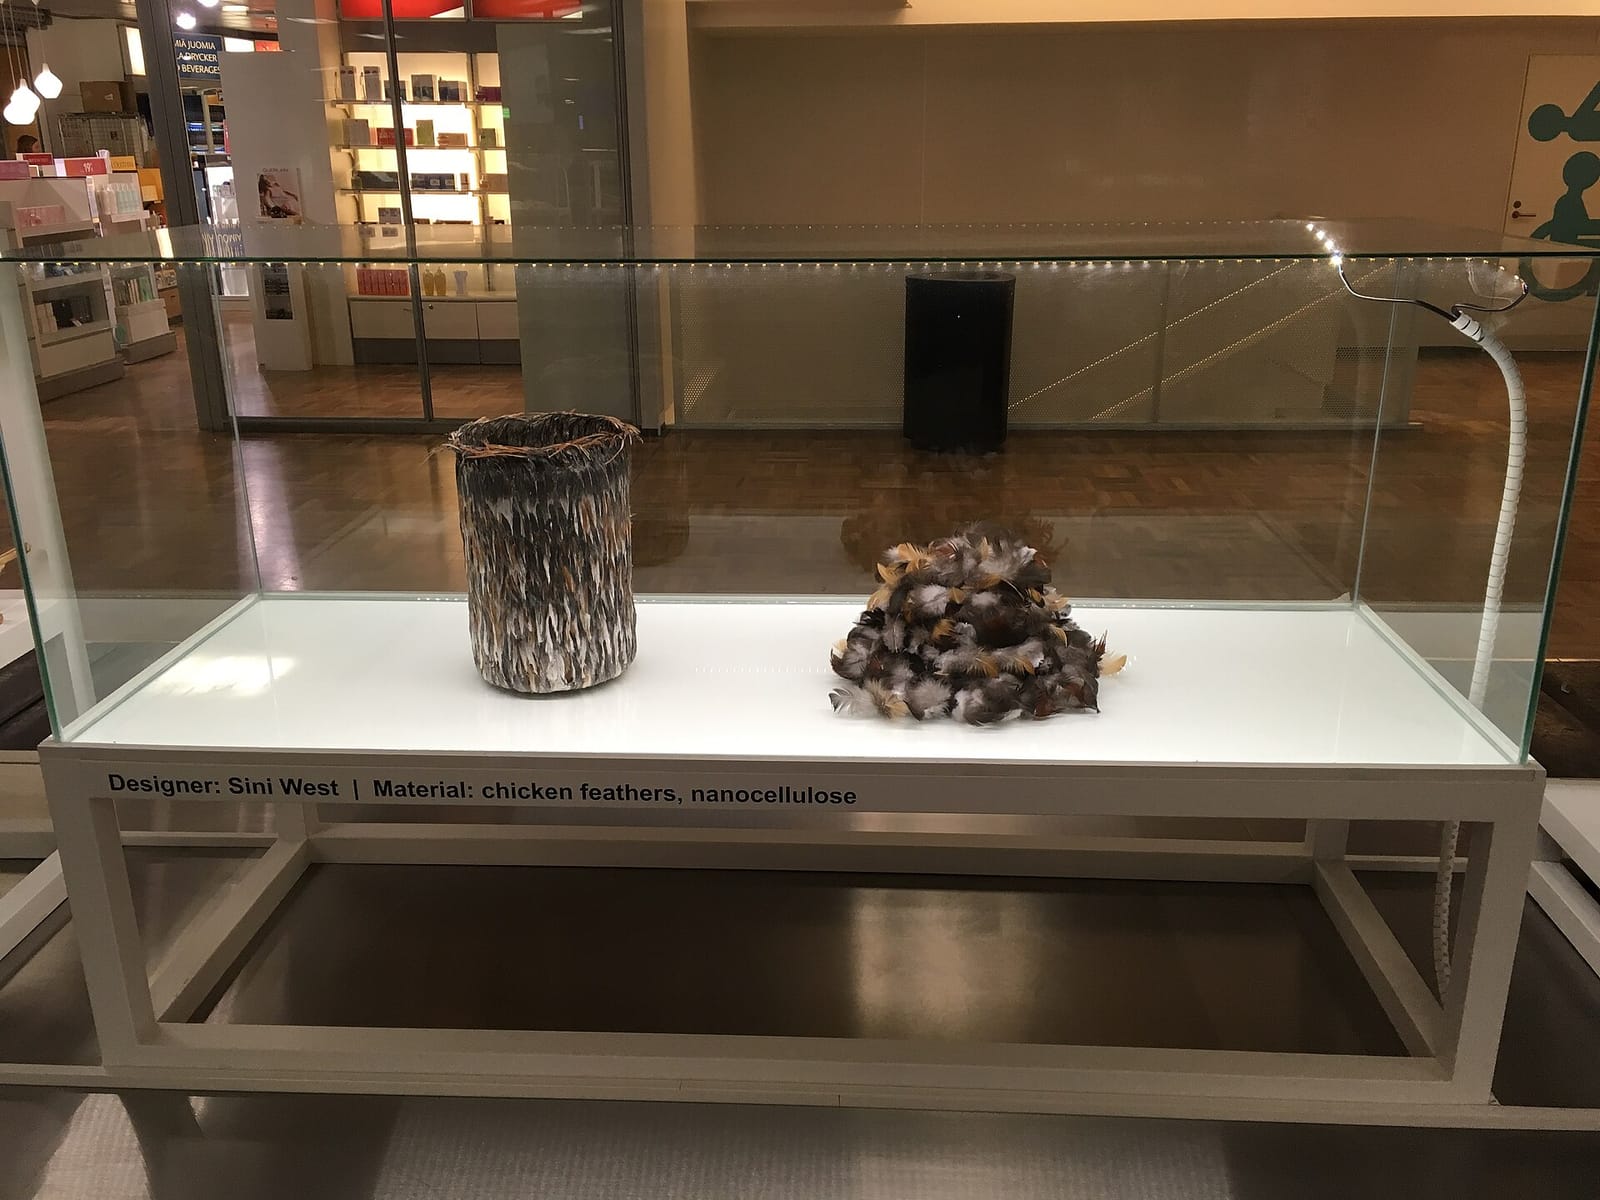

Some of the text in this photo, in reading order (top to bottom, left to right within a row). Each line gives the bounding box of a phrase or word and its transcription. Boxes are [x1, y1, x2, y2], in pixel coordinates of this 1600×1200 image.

[187, 40, 216, 50] JUOMIA
[184, 52, 218, 62] DRYCKER
[108, 774, 220, 797] Designer:
[228, 776, 275, 795] Sini
[279, 777, 339, 797] West
[372, 779, 474, 799] Material:
[482, 781, 573, 801] chicken
[580, 782, 683, 805] feathers,
[691, 785, 857, 805] nanocellulose
